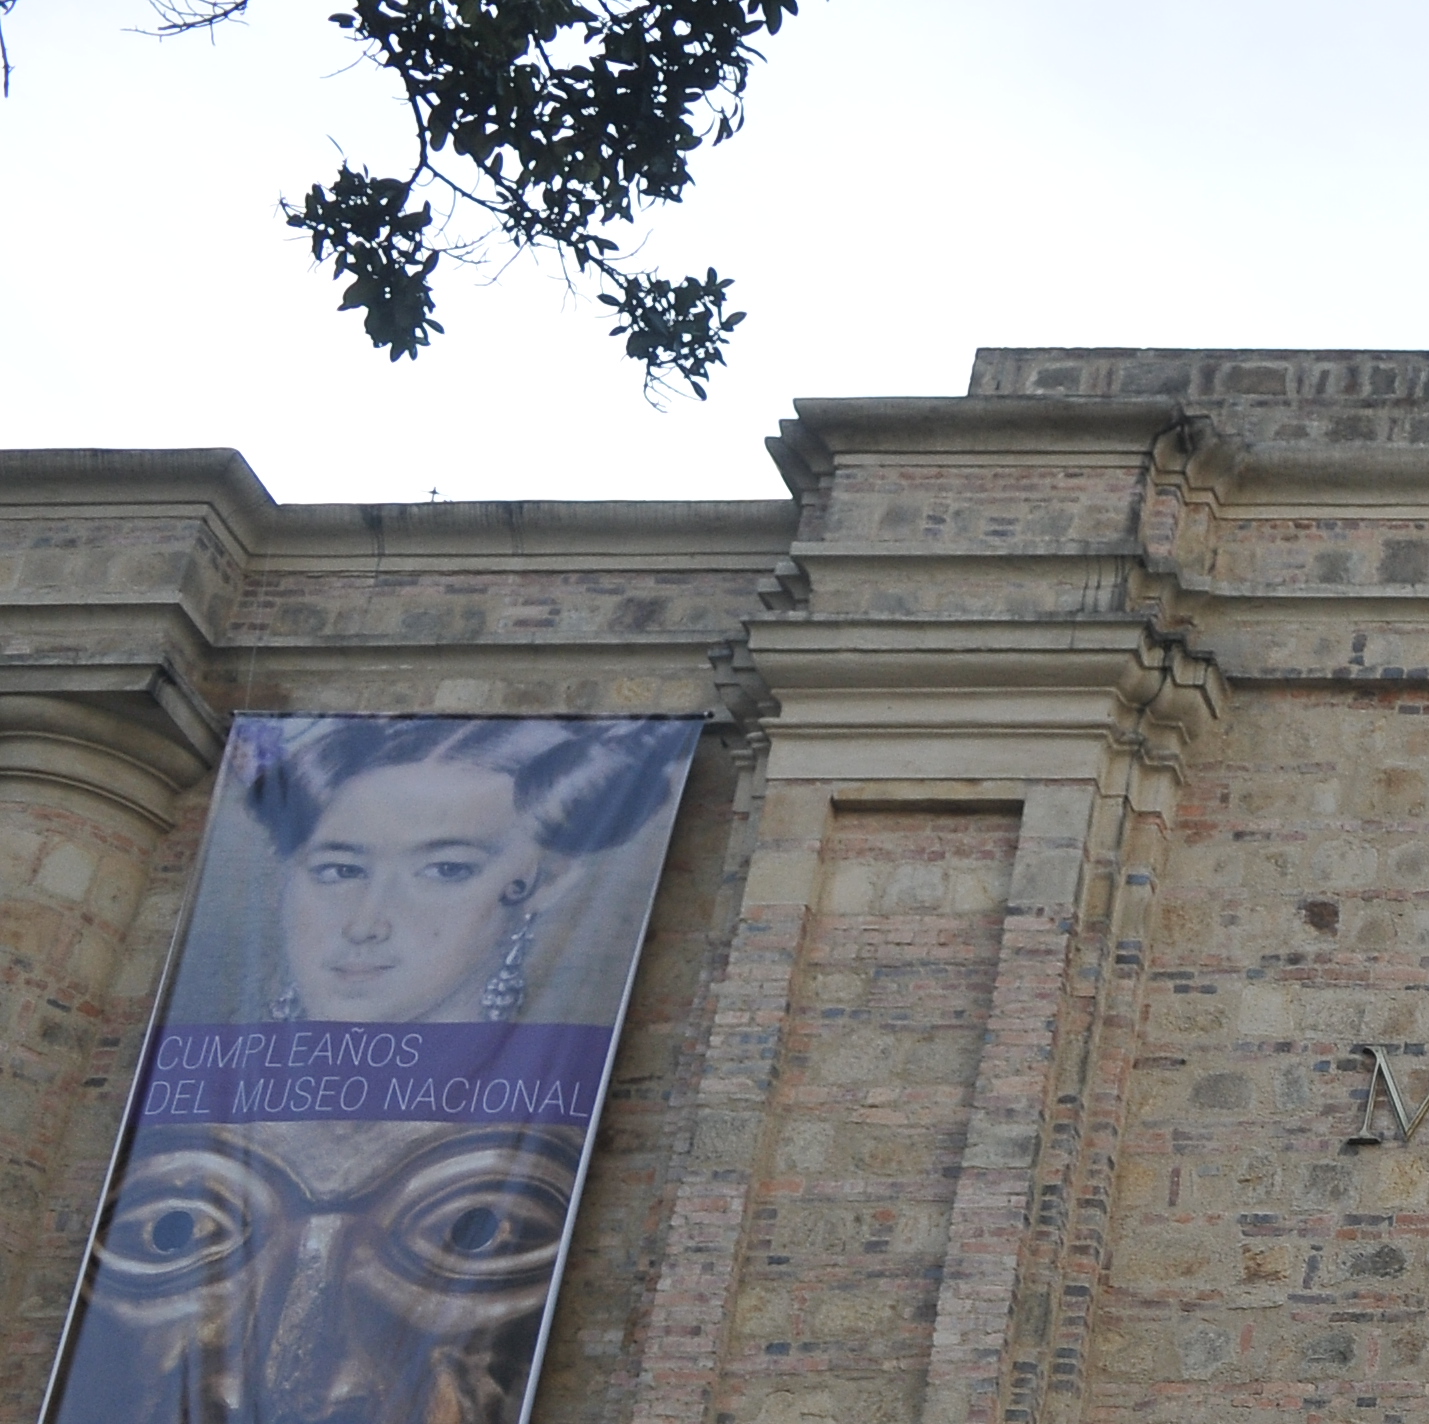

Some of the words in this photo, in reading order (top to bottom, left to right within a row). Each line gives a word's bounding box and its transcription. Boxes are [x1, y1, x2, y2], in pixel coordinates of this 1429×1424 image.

[156, 1026, 422, 1071] CUMPLEAÑOS
[144, 1080, 210, 1116] DEL
[232, 1076, 368, 1114] MUSEO
[384, 1076, 589, 1118] NACIONAL
